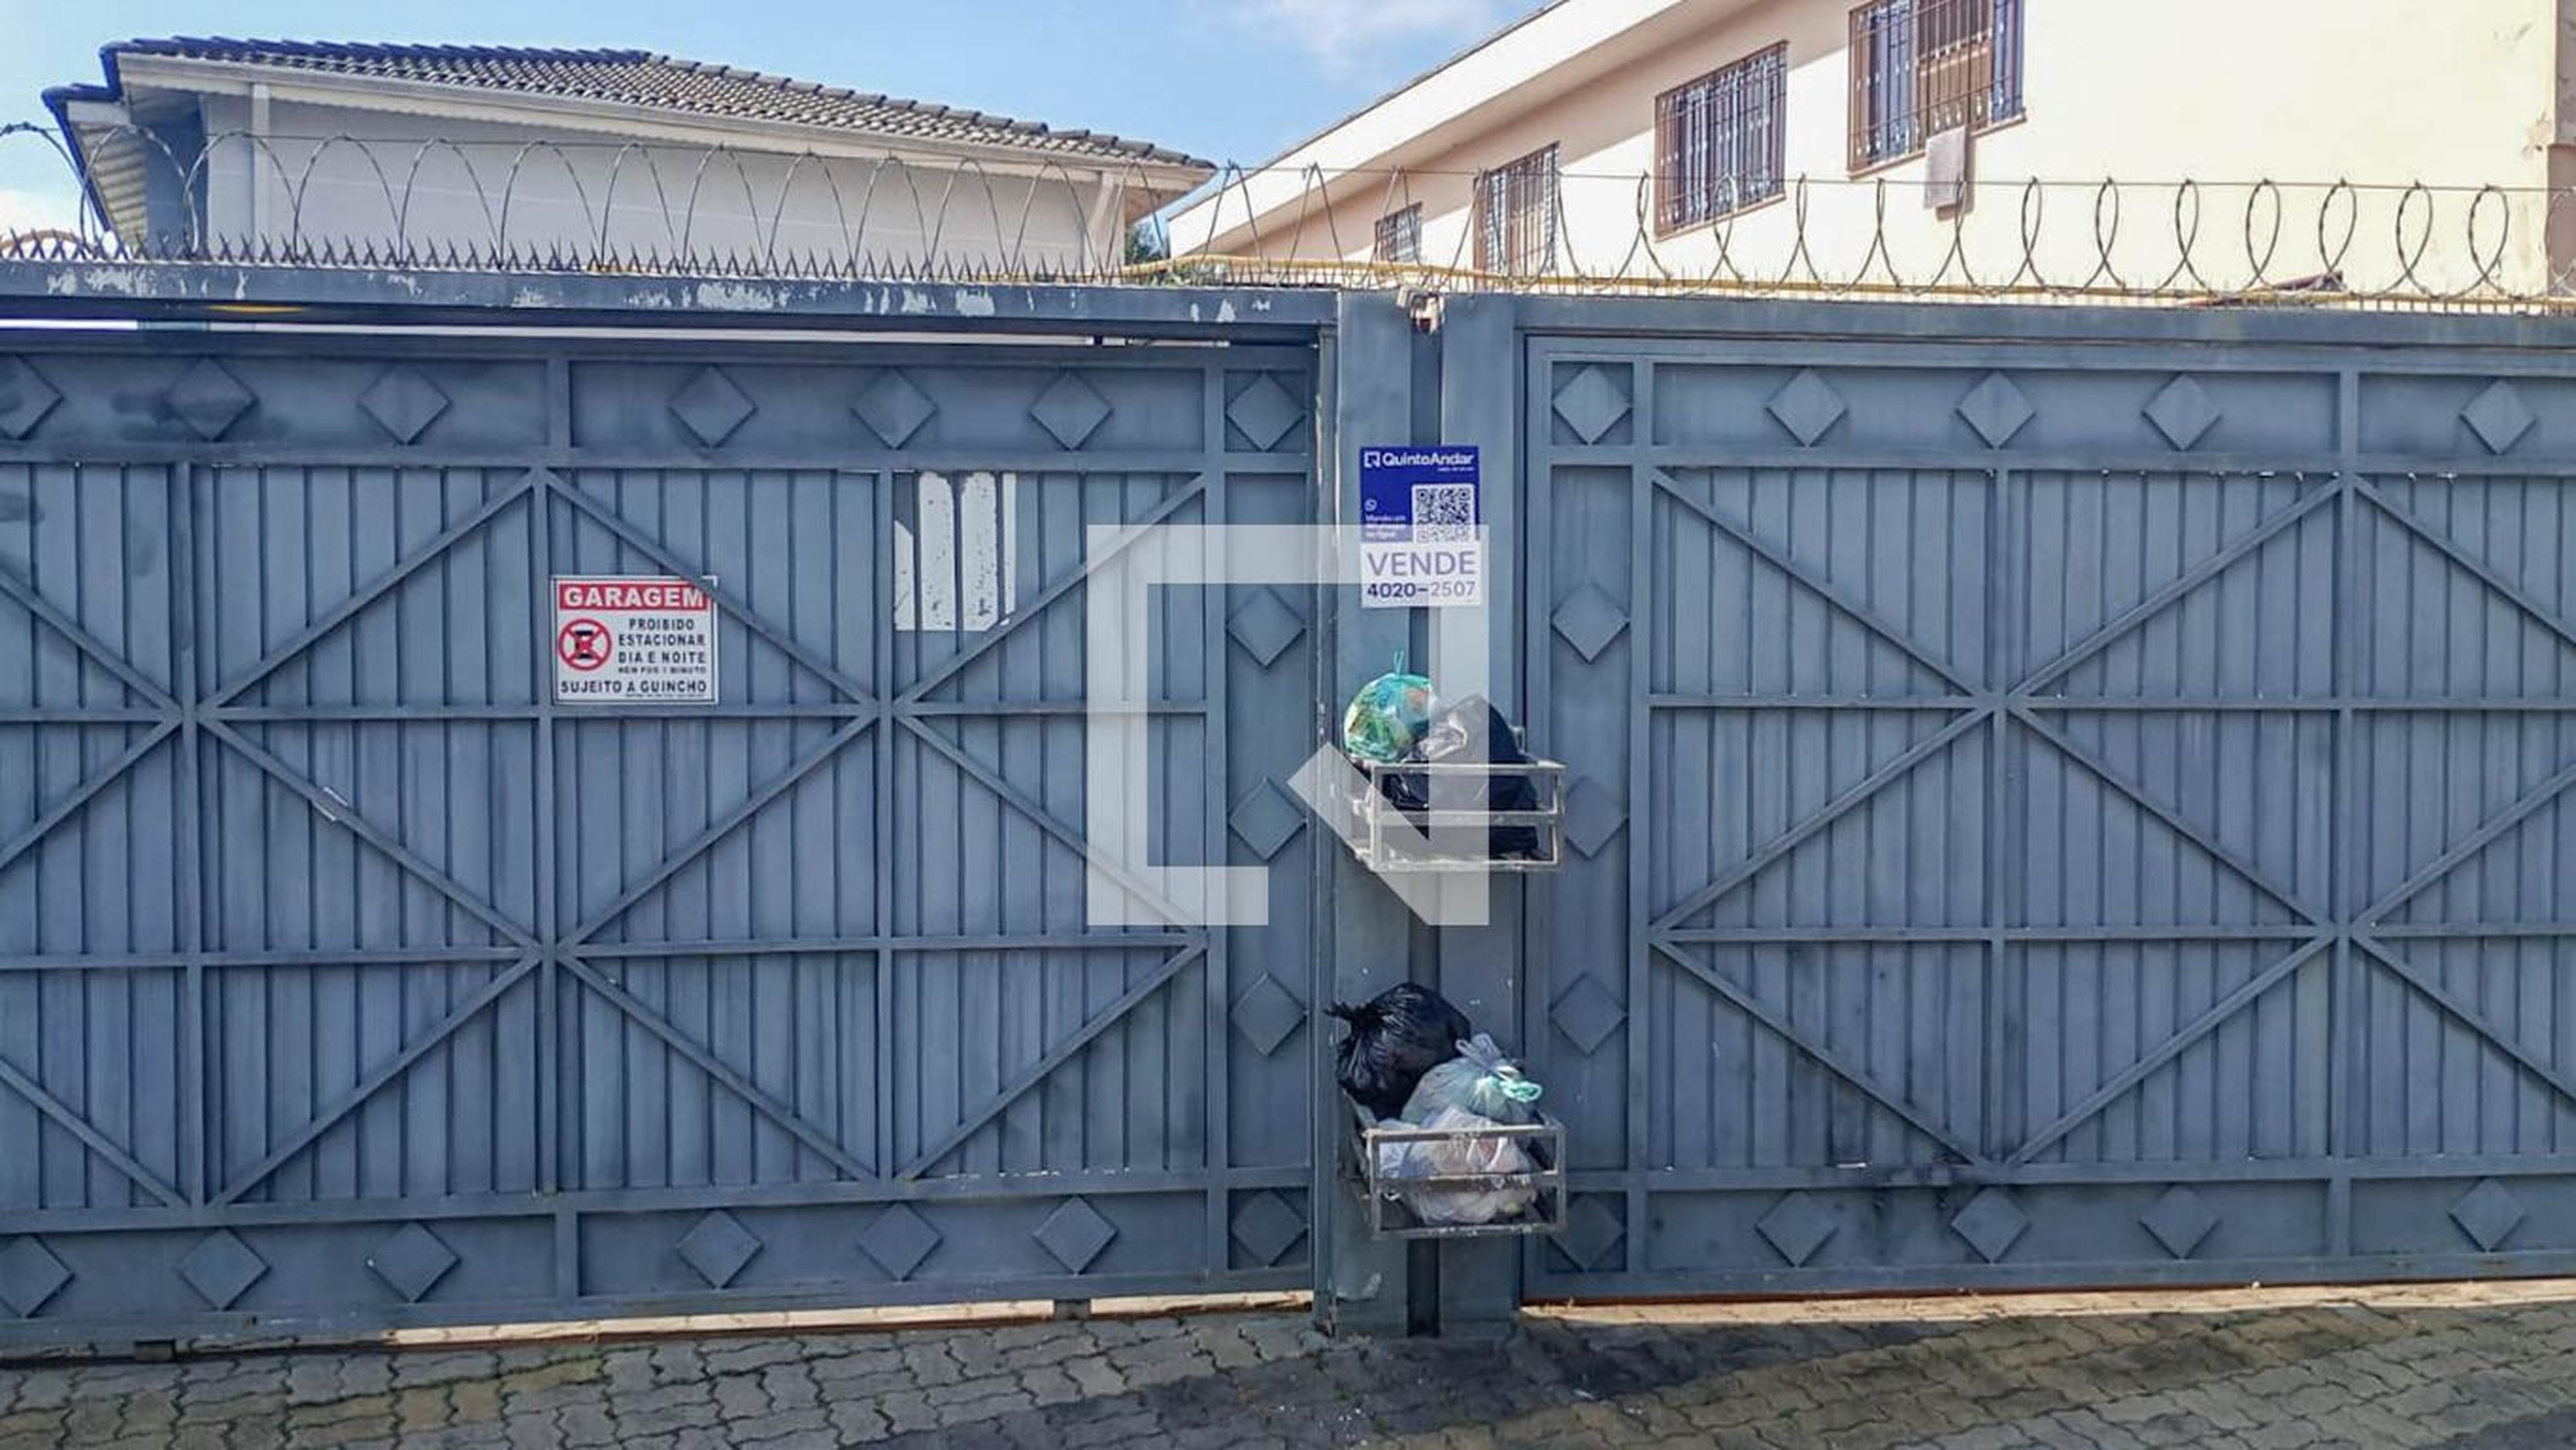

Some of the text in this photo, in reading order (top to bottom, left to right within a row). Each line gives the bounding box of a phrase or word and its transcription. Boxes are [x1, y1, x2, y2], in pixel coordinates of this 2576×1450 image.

[1382, 452, 1474, 466] QuintoAndar
[1367, 551, 1476, 576] VENDE
[1367, 581, 1476, 598] 4020-2507
[564, 586, 703, 607] GARAGEM
[629, 619, 694, 630] PROIBIDO
[619, 635, 706, 646] ESTACIONAR
[619, 652, 705, 663] DIA E NOITE
[561, 680, 707, 693] SUJEITO A GUINCHO
